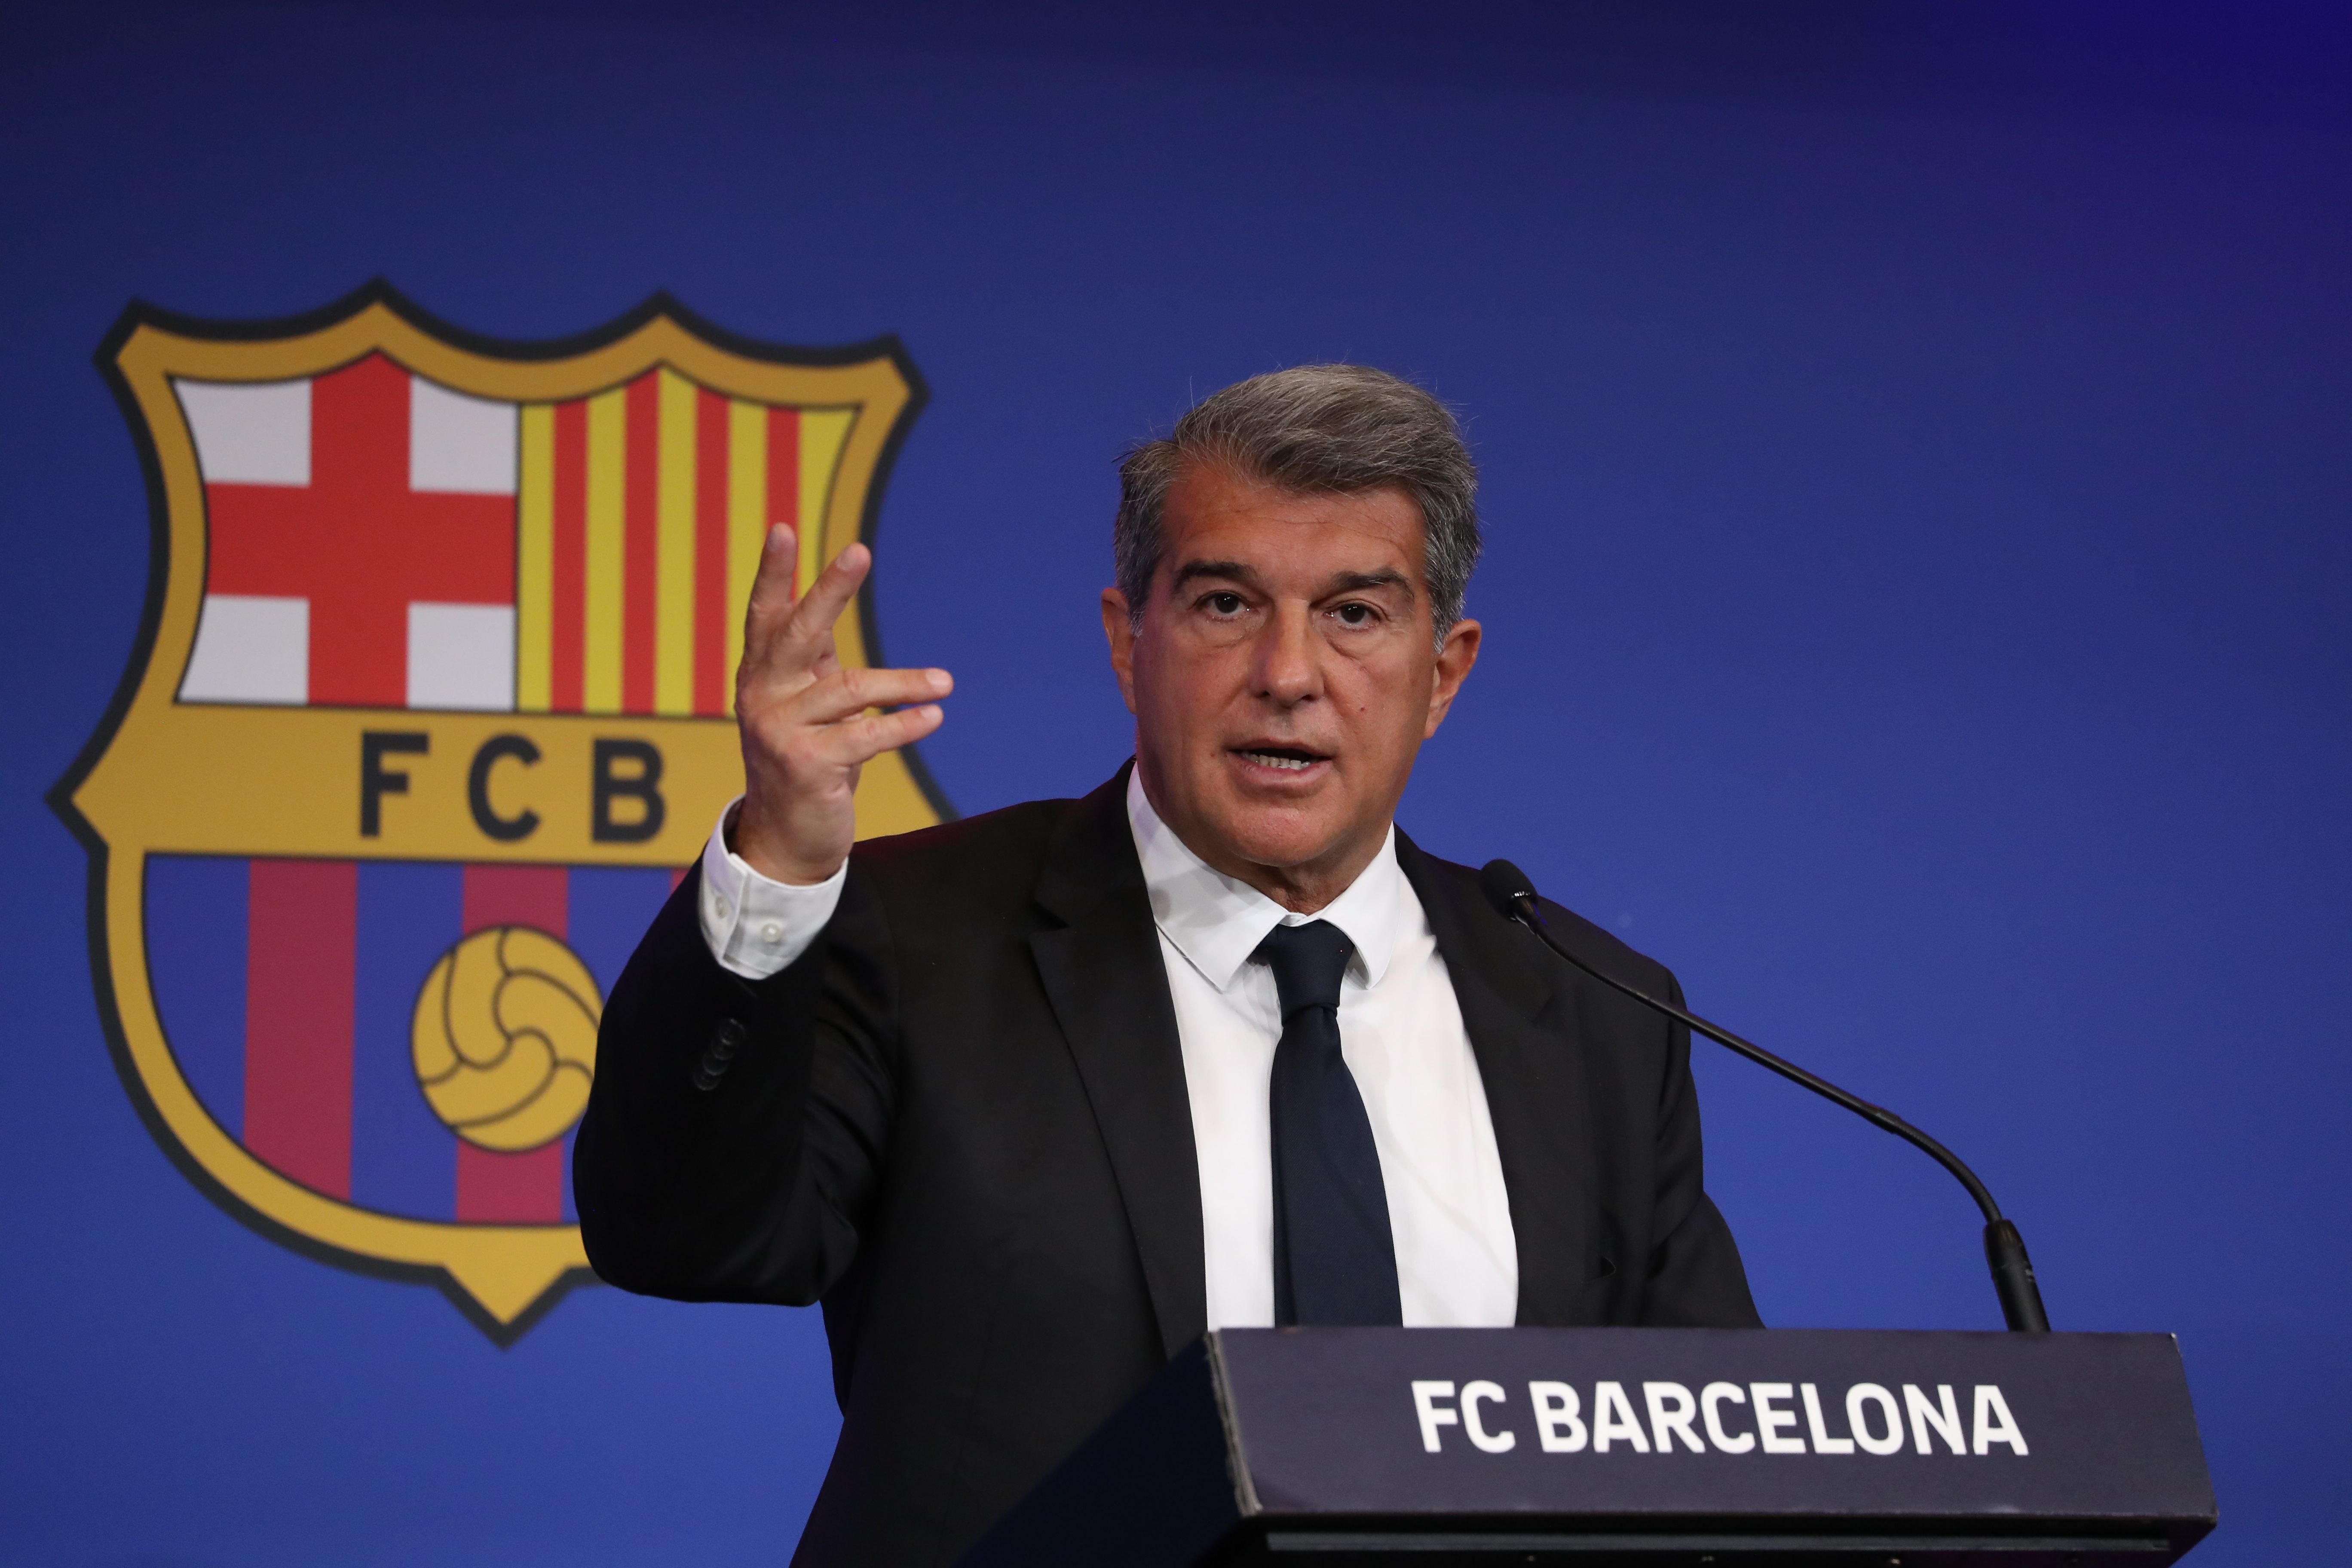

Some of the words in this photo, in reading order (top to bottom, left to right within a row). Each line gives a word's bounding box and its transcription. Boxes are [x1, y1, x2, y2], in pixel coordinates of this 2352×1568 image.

[358, 729, 667, 844] FCB
[1411, 1380, 1516, 1454] FC
[1528, 1380, 2029, 1456] BARCELONA
